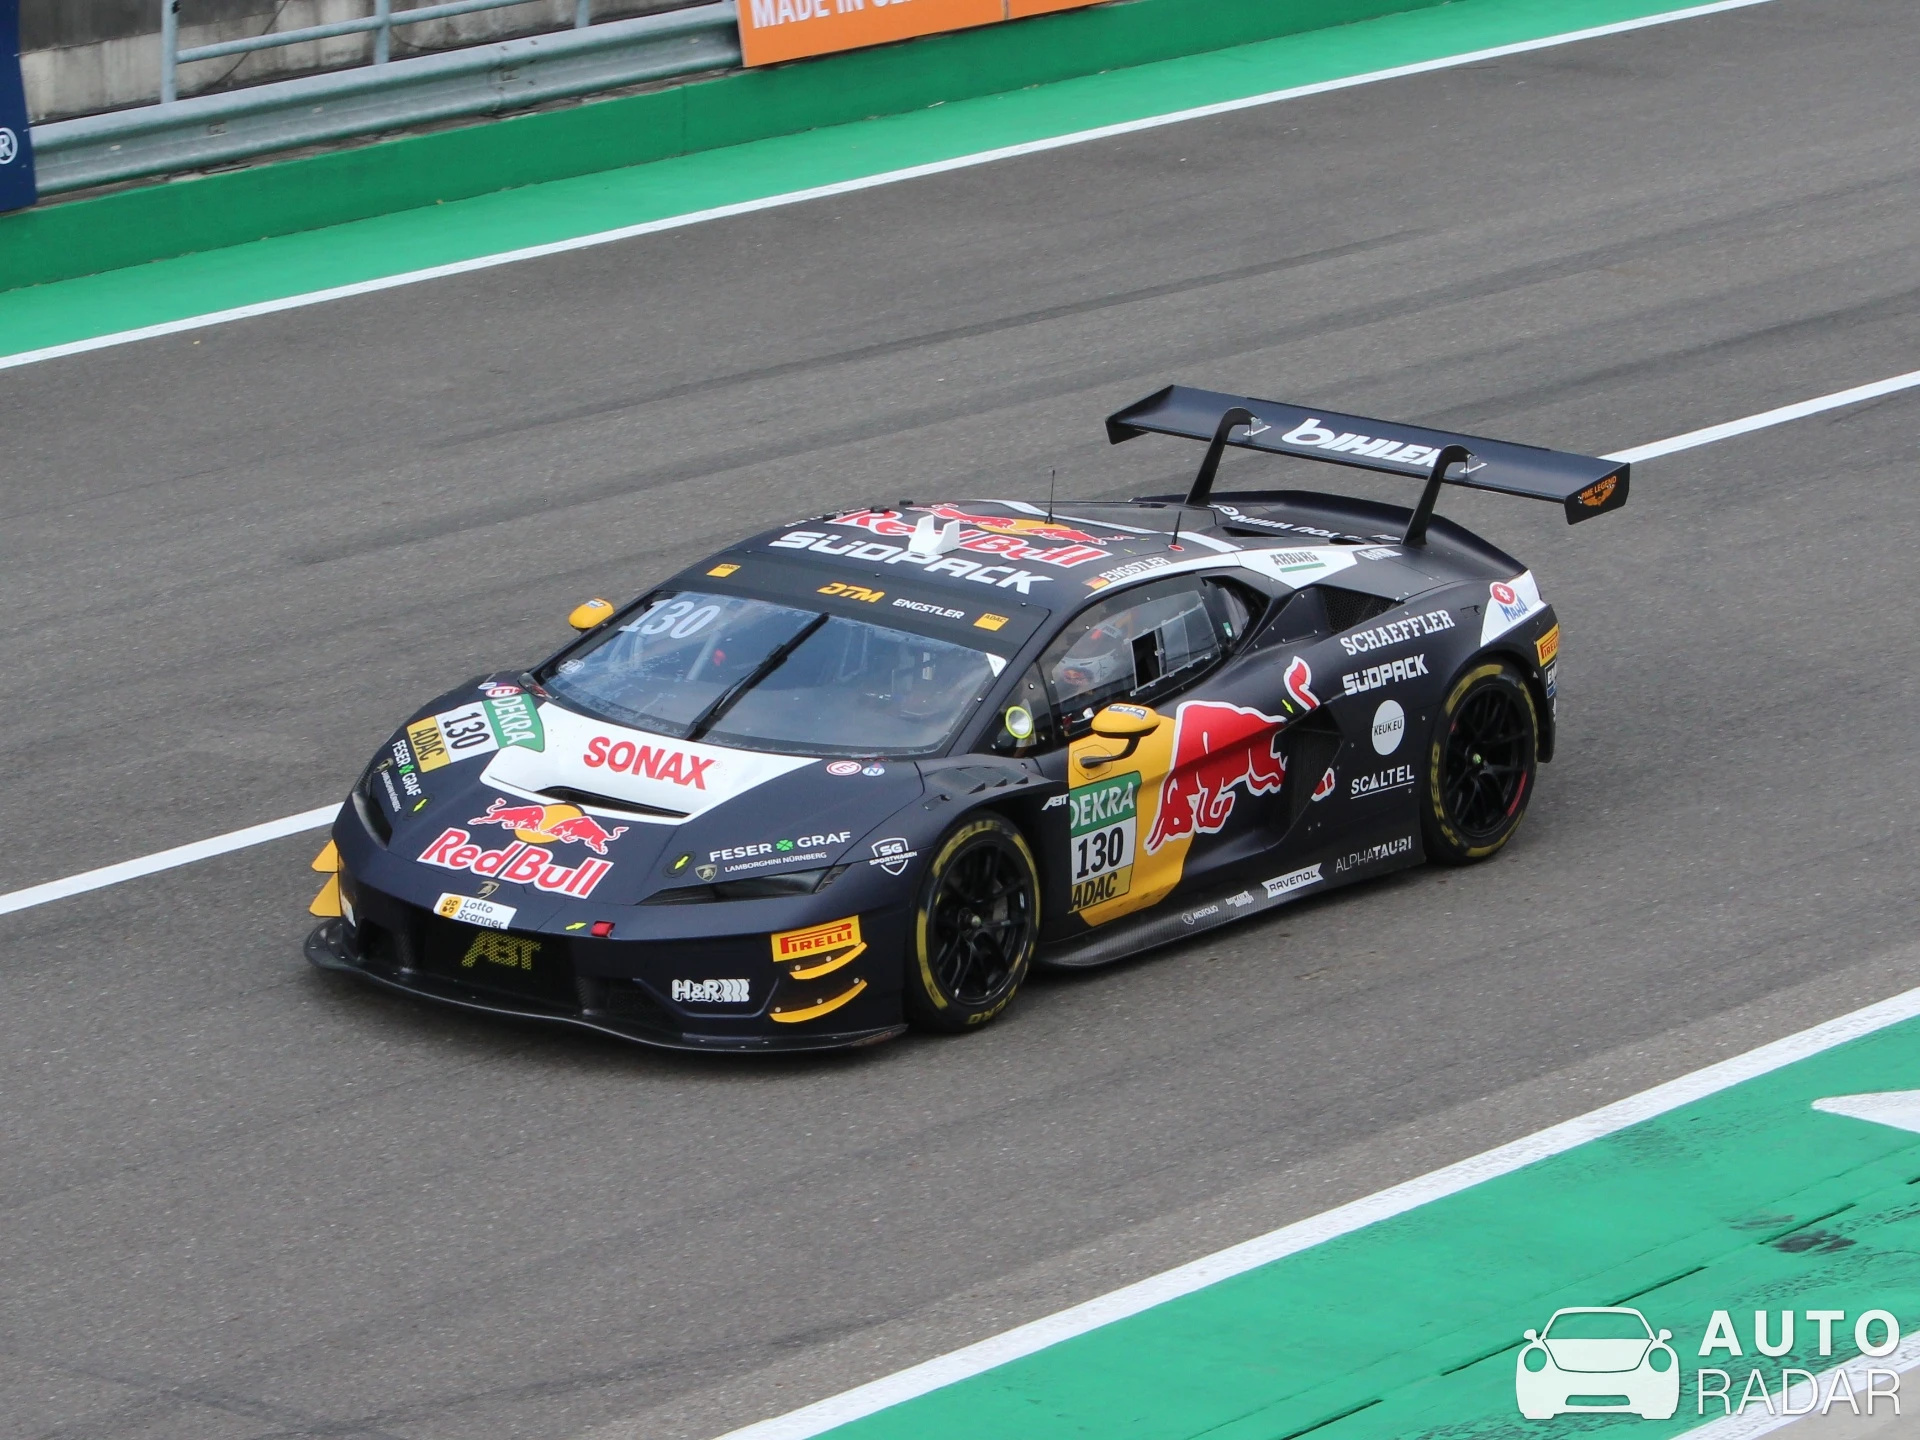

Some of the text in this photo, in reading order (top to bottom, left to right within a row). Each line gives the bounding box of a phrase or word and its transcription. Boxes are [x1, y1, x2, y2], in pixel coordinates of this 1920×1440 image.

[1594, 476, 1617, 493] LEGEND
[768, 530, 1054, 595] SÜDPACK
[953, 532, 1113, 569] Bull
[1099, 557, 1171, 582] ENGSTLER
[816, 582, 886, 603] DTM
[892, 598, 965, 620] ENGSTLER
[618, 599, 721, 639] 130
[1340, 609, 1456, 656] SCHAEFFLER
[1342, 654, 1429, 697] SÜDPACK
[443, 712, 491, 750] 130
[491, 695, 536, 745] DEKRA
[1373, 719, 1403, 736] KEUK.EU
[411, 727, 445, 761] ADAC
[392, 739, 422, 796] FESER GRAF
[583, 736, 716, 790] SONAX
[1351, 764, 1415, 796] SCALTEL
[709, 831, 851, 862] FESER GRAF
[724, 851, 828, 873] LAMBORGHINI NÜRNBERG
[879, 842, 903, 857] SG
[1076, 827, 1124, 879] 130
[417, 827, 615, 900] Red Bull
[1071, 871, 1118, 912] ADAC
[1269, 871, 1317, 893] RAVENOL
[457, 911, 505, 930] Scanner
[463, 899, 494, 914] Lotto
[461, 930, 542, 970] ABT
[780, 923, 852, 954] PIRELLI
[672, 979, 724, 1003] H&R
